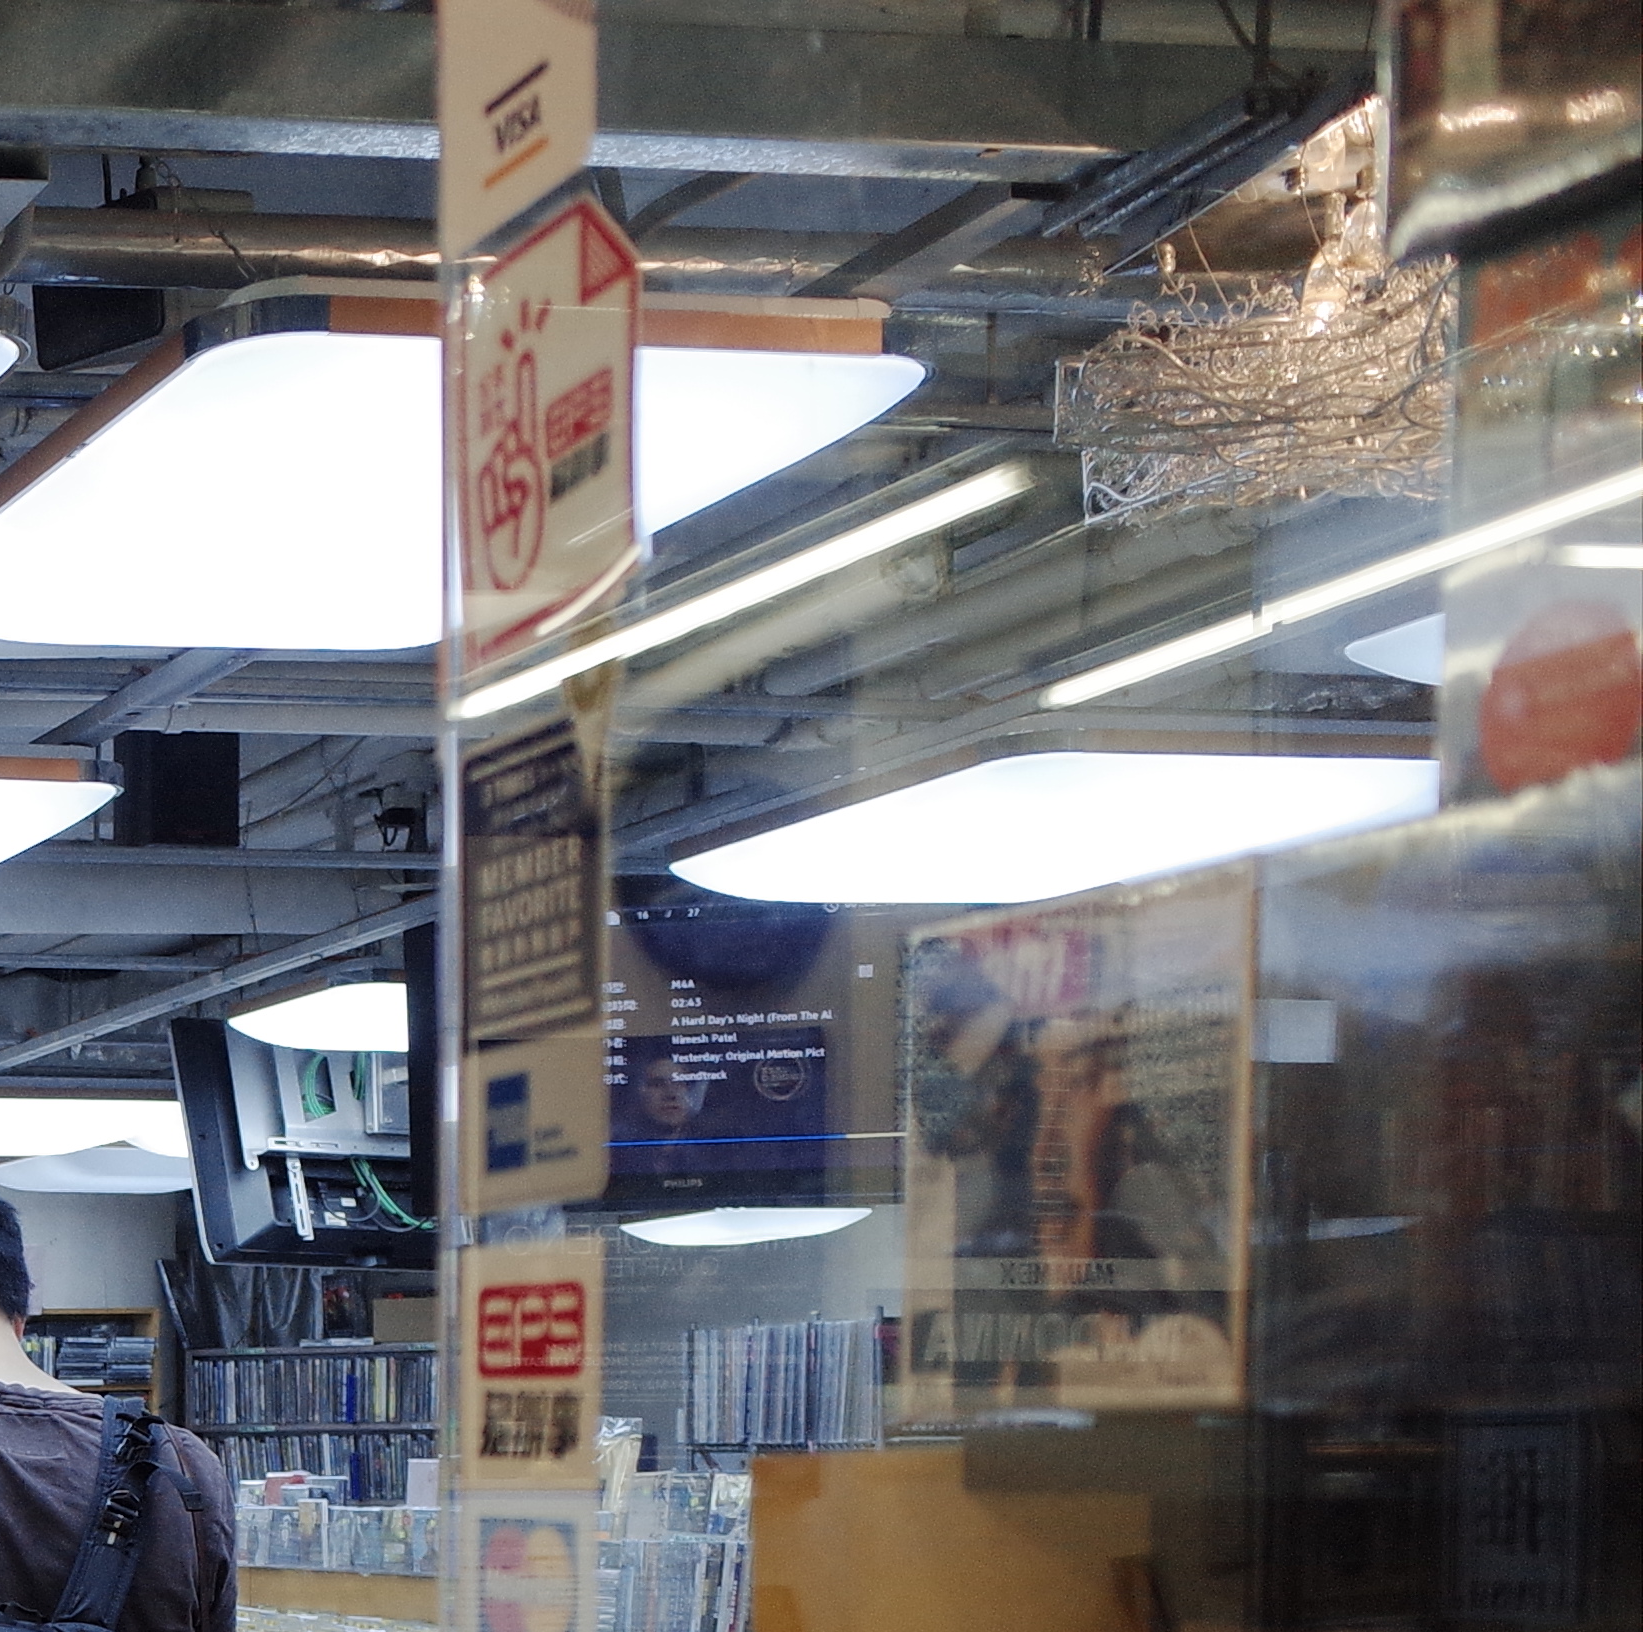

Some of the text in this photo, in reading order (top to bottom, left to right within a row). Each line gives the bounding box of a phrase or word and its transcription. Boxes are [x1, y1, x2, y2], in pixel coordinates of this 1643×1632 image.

[671, 1017, 680, 1027] A
[682, 1014, 705, 1026] Hard
[707, 1014, 734, 1026] Day's
[737, 1013, 765, 1026] Night
[767, 1011, 798, 1024] (From
[799, 1011, 819, 1021] The
[671, 1032, 737, 1045] Himesh Patel
[671, 1047, 826, 1065] Yesterday: Original Motion Pict
[671, 1070, 728, 1082] Soundtrack
[664, 1178, 703, 1188] PHILIPS
